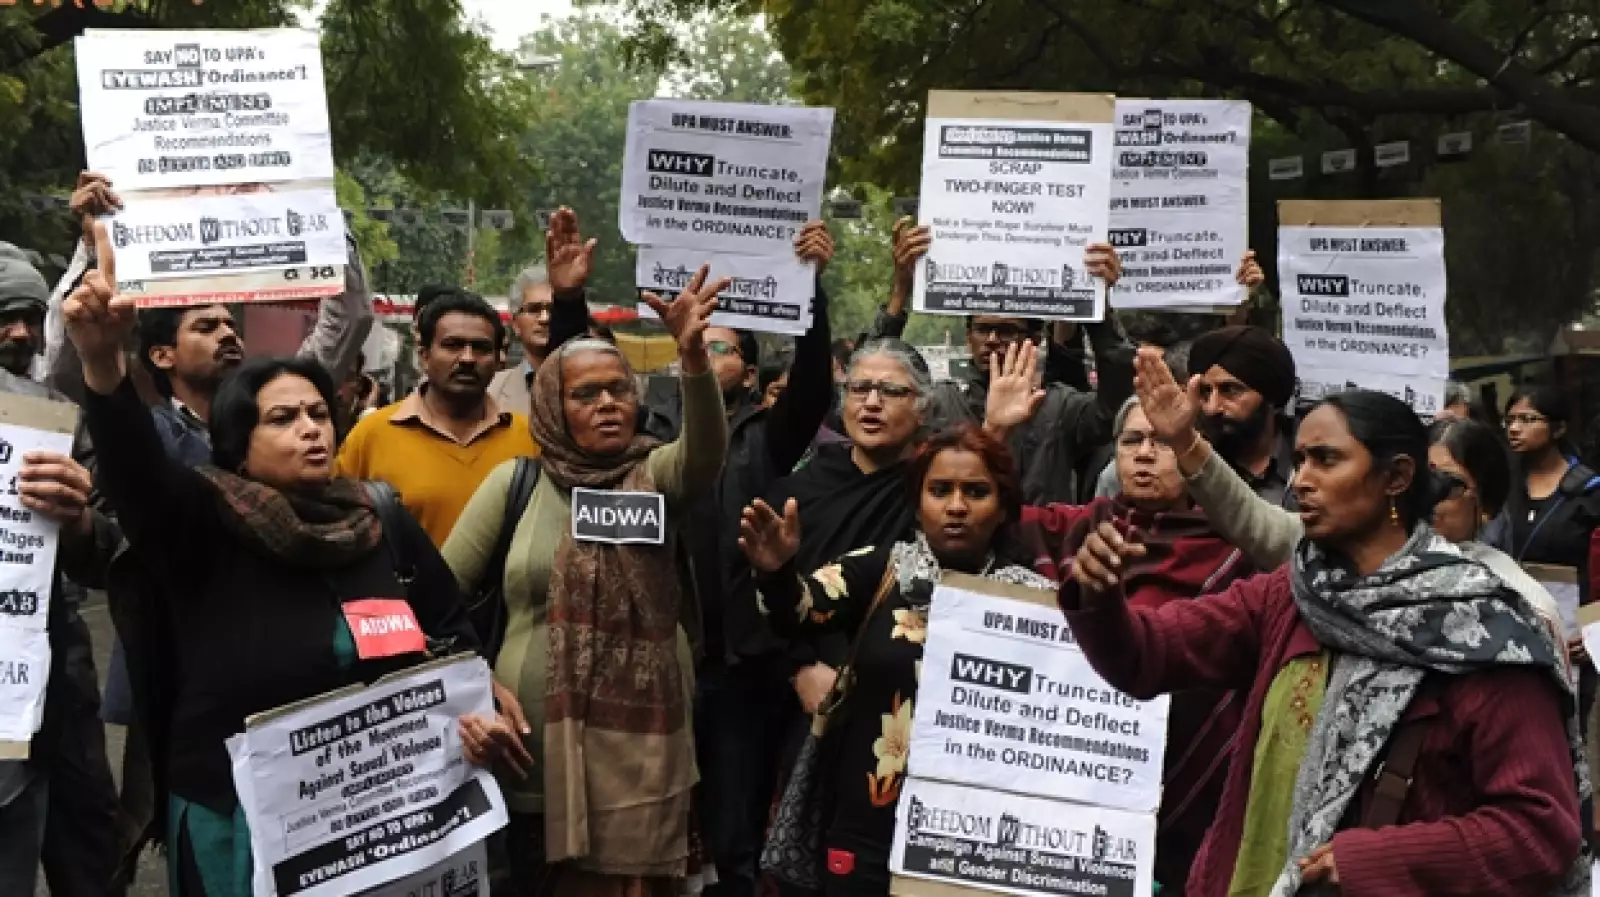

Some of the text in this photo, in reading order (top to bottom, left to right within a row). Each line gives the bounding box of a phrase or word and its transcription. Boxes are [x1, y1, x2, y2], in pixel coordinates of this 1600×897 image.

[144, 49, 172, 64] SAY
[203, 47, 220, 61] TO
[134, 117, 175, 131] Justice
[224, 112, 290, 127] Committee
[671, 112, 696, 128] UPA
[700, 114, 736, 132] MUST
[1122, 114, 1143, 127] SAY
[1164, 114, 1178, 126] TO
[154, 133, 272, 149] Recommendations
[1116, 131, 1159, 145] WASH
[649, 151, 804, 184] WHY Truncate,
[989, 162, 1043, 176] SCRAP
[648, 176, 801, 204] Dilute and Deflect
[945, 179, 1086, 199] TWO-FINGER TEST
[992, 200, 1036, 215] NOW!
[1130, 196, 1160, 209] MUST
[112, 220, 196, 248] FREEDOM
[200, 216, 283, 244] WITHOUT
[646, 214, 796, 241] in the ORDINANCE?
[1299, 275, 1347, 295] WHY
[576, 503, 660, 527] AIDWA
[359, 613, 417, 638] AIDWA
[983, 609, 1015, 630] UPA
[1015, 616, 1058, 641] MUST
[955, 655, 1142, 711] WHY Truncate,
[293, 686, 443, 753] Listen to the Voices
[950, 685, 1141, 737] Dilute and Deflect
[935, 709, 1150, 762] Justice Verma Recommendations
[315, 744, 332, 768] of
[339, 739, 363, 760] the
[945, 737, 1134, 785] in the ORDINANCE?
[908, 796, 1138, 861] FREEDOM WITHOUT FEAR
[929, 856, 956, 873] and
[958, 860, 1008, 881] Gender
